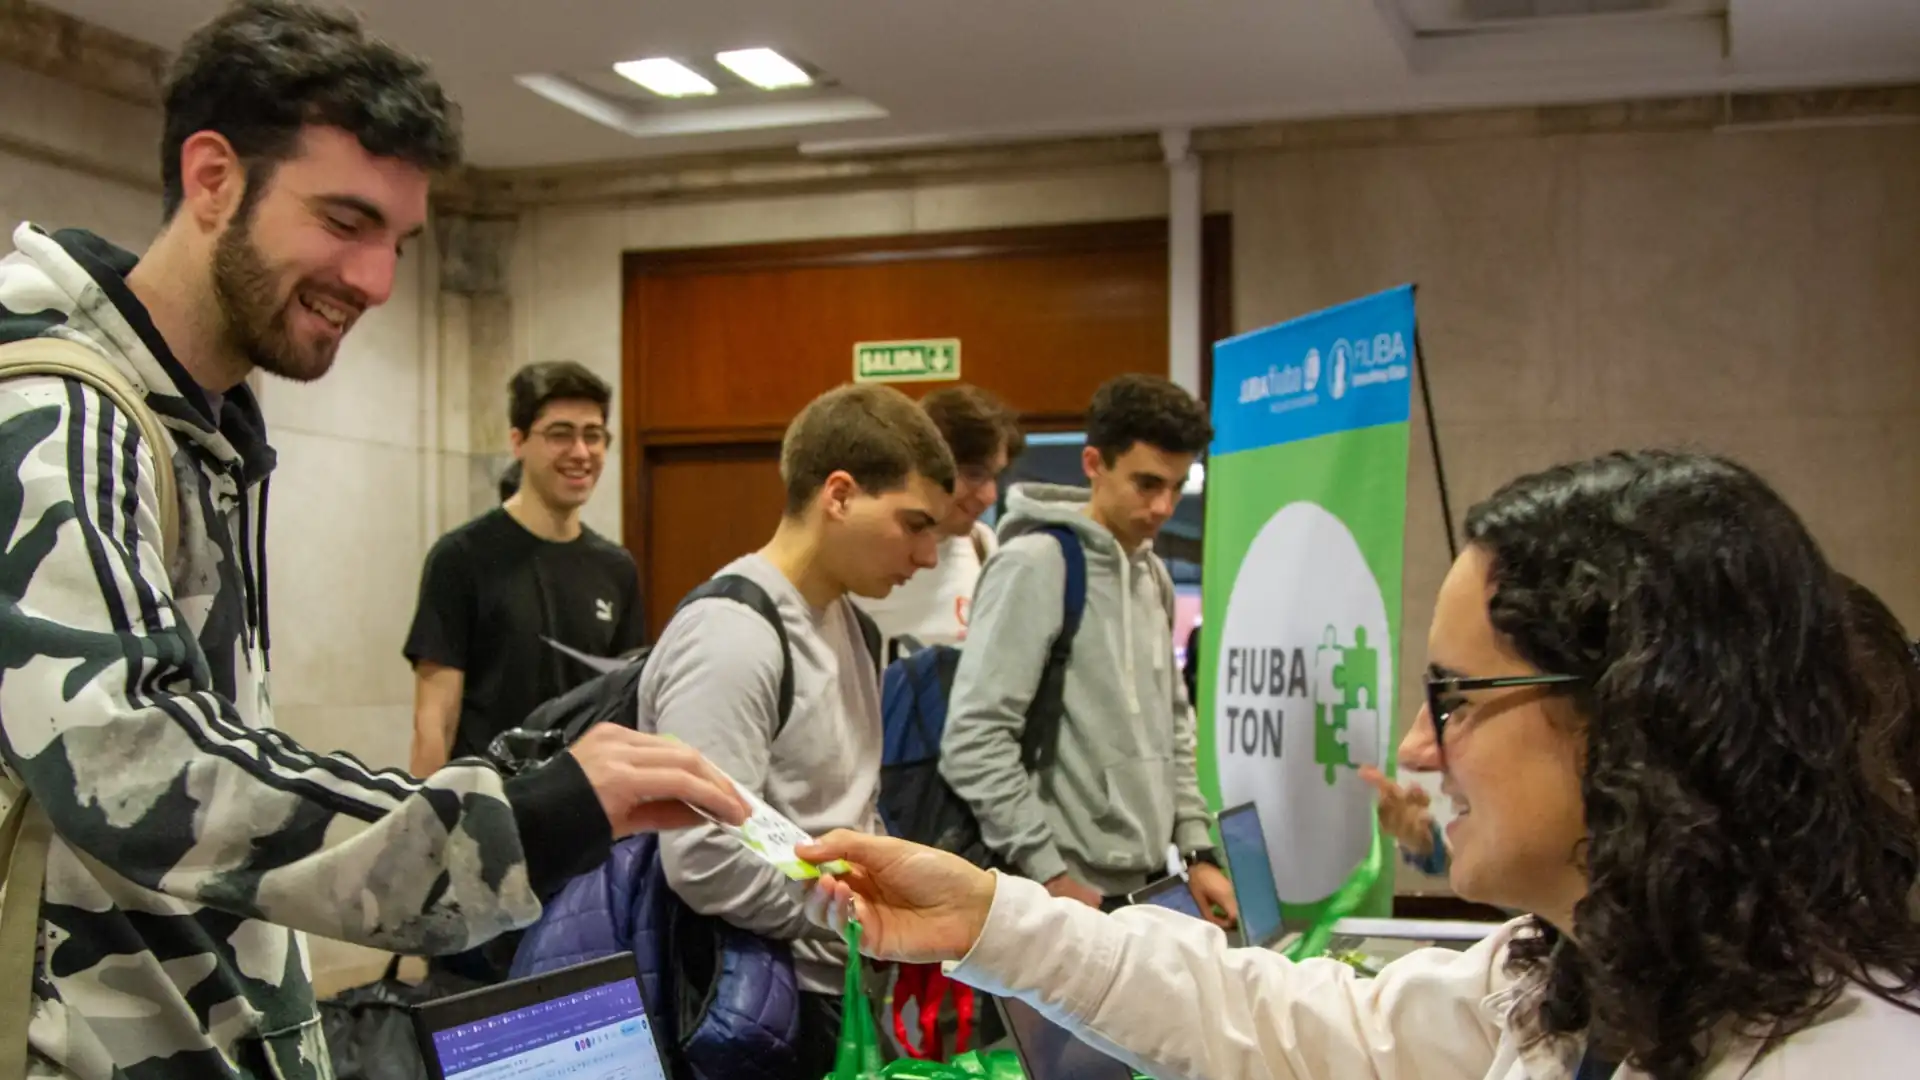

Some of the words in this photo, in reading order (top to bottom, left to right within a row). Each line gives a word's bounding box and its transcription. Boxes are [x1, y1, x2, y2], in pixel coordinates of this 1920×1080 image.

[861, 349, 927, 372] SALIDA
[1226, 647, 1308, 698] FIUBA
[1226, 706, 1284, 758] TON
